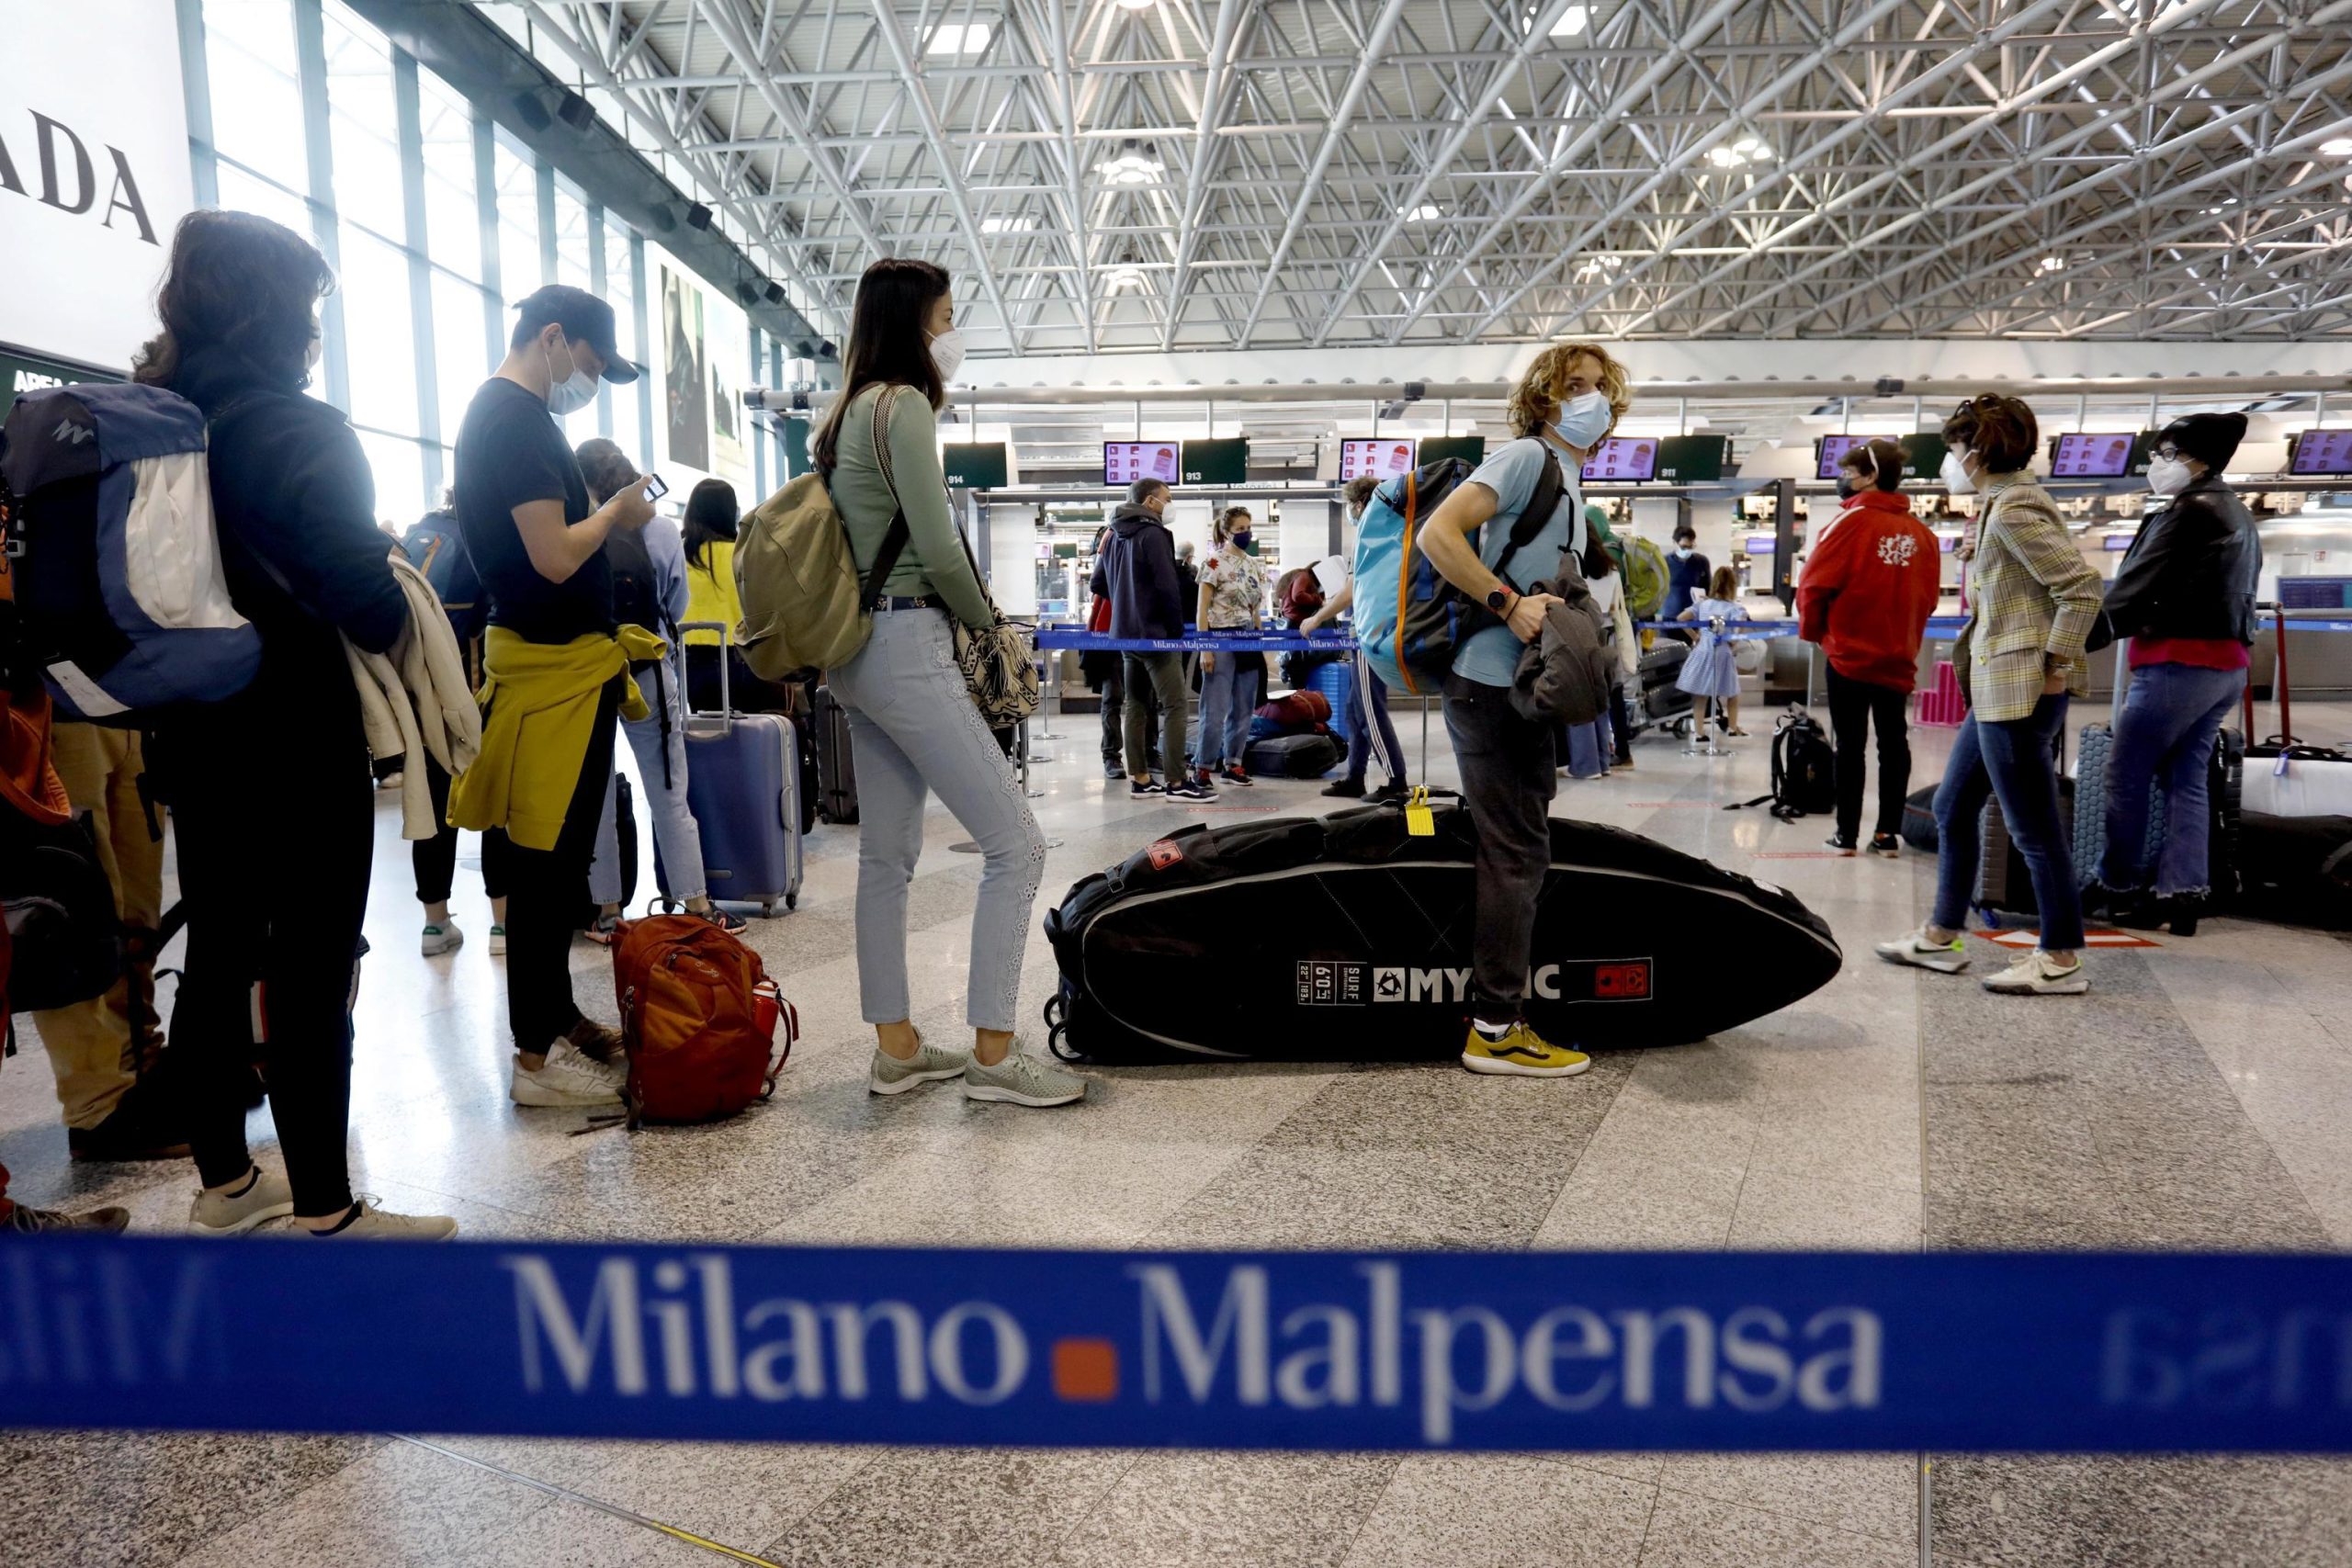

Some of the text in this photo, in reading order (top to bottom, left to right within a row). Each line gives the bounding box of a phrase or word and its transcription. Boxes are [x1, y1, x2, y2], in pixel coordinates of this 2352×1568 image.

[1186, 471, 1202, 480] 913
[1661, 468, 1676, 477] 911
[947, 475, 963, 484] 914
[1152, 639, 1179, 649] Milano
[1182, 639, 1219, 651] Malpensa
[1308, 639, 1334, 649] Milano
[1348, 967, 1360, 999] SURF
[1409, 964, 1561, 1003] MYIC
[501, 1254, 1883, 1444] Milano Malpensa
